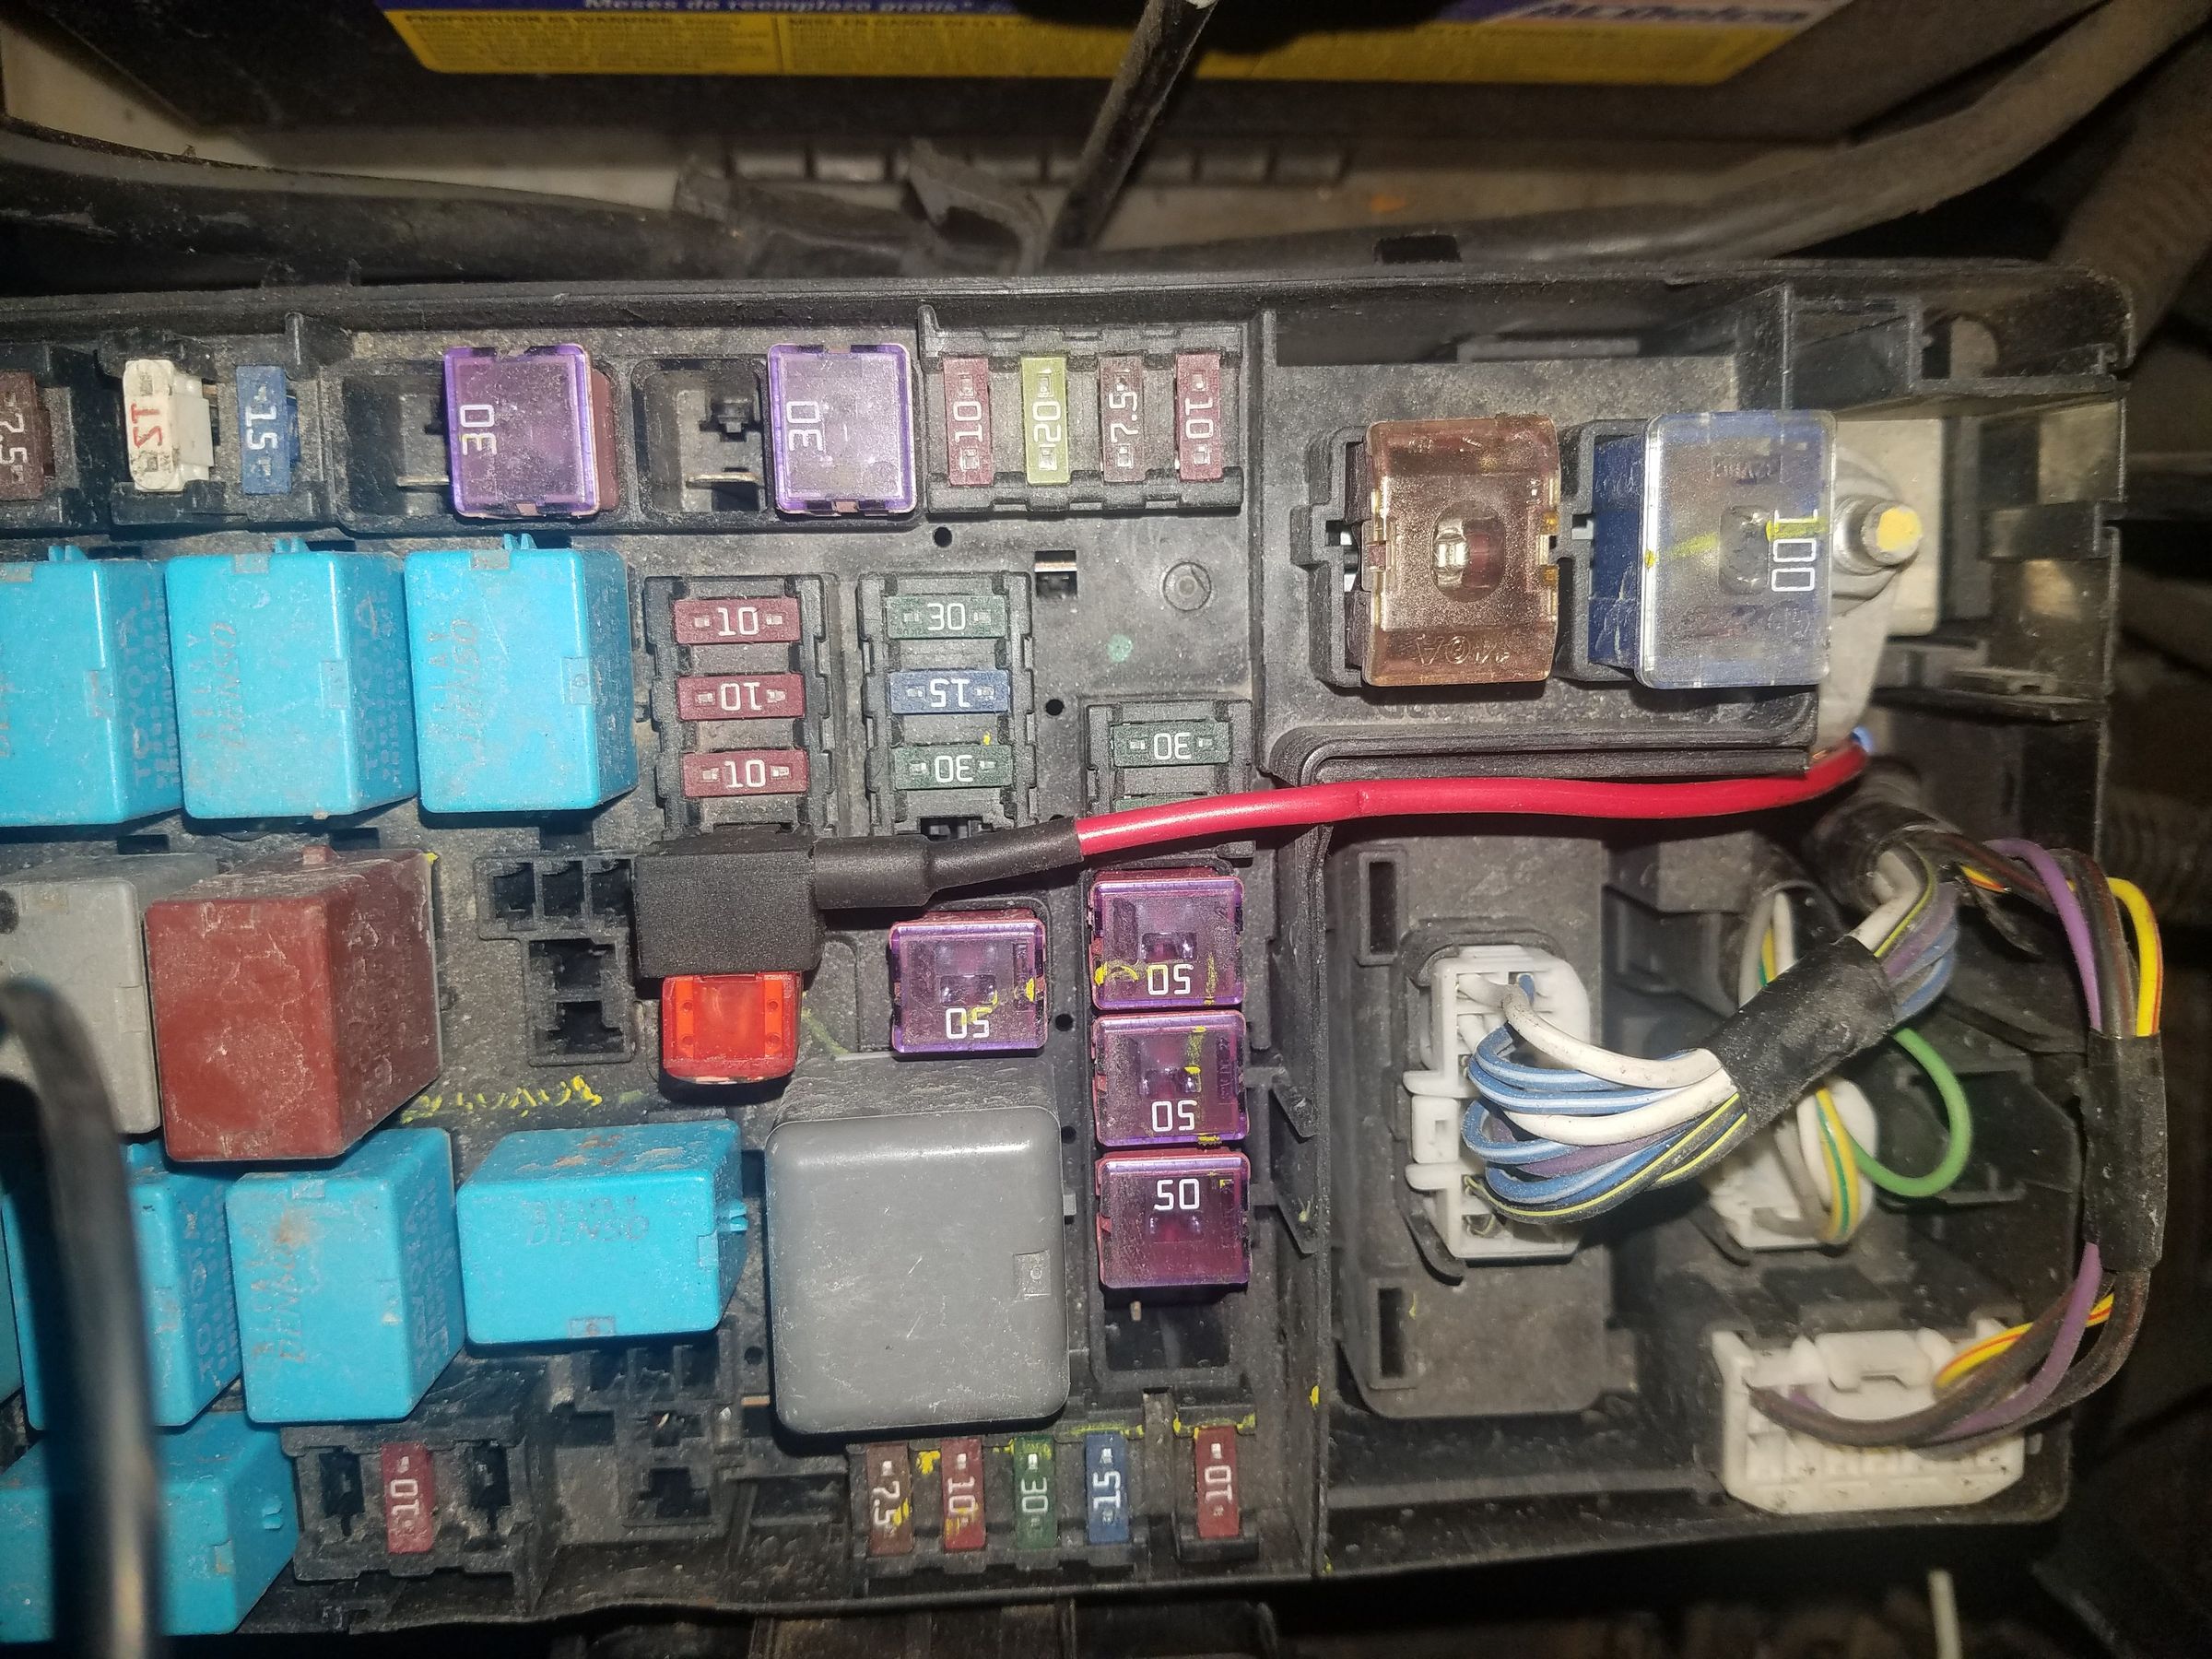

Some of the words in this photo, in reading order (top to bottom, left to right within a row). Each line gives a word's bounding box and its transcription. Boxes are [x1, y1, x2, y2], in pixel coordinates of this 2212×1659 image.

[244, 406, 278, 450] 15
[460, 404, 498, 456] 30
[786, 401, 824, 452] 30
[953, 401, 983, 442] 10
[1032, 400, 1063, 442] 20
[1108, 391, 1139, 443] 7.5
[1184, 397, 1215, 439] 10
[1771, 509, 1818, 592] 100
[717, 606, 759, 636] 10
[927, 603, 967, 631] 30
[720, 682, 763, 711] 10
[929, 677, 971, 708] 15
[1153, 732, 1193, 760] 30
[724, 759, 766, 789] 10
[935, 754, 974, 782] 30
[1147, 963, 1194, 995] 50
[946, 1007, 993, 1039] 50
[1152, 1100, 1198, 1133] 50
[1154, 1178, 1200, 1210] 50
[390, 1478, 420, 1516] 10
[947, 1477, 977, 1513] 10
[1020, 1477, 1049, 1513] 30
[1092, 1470, 1122, 1511] 15
[1205, 1465, 1233, 1504] 10
